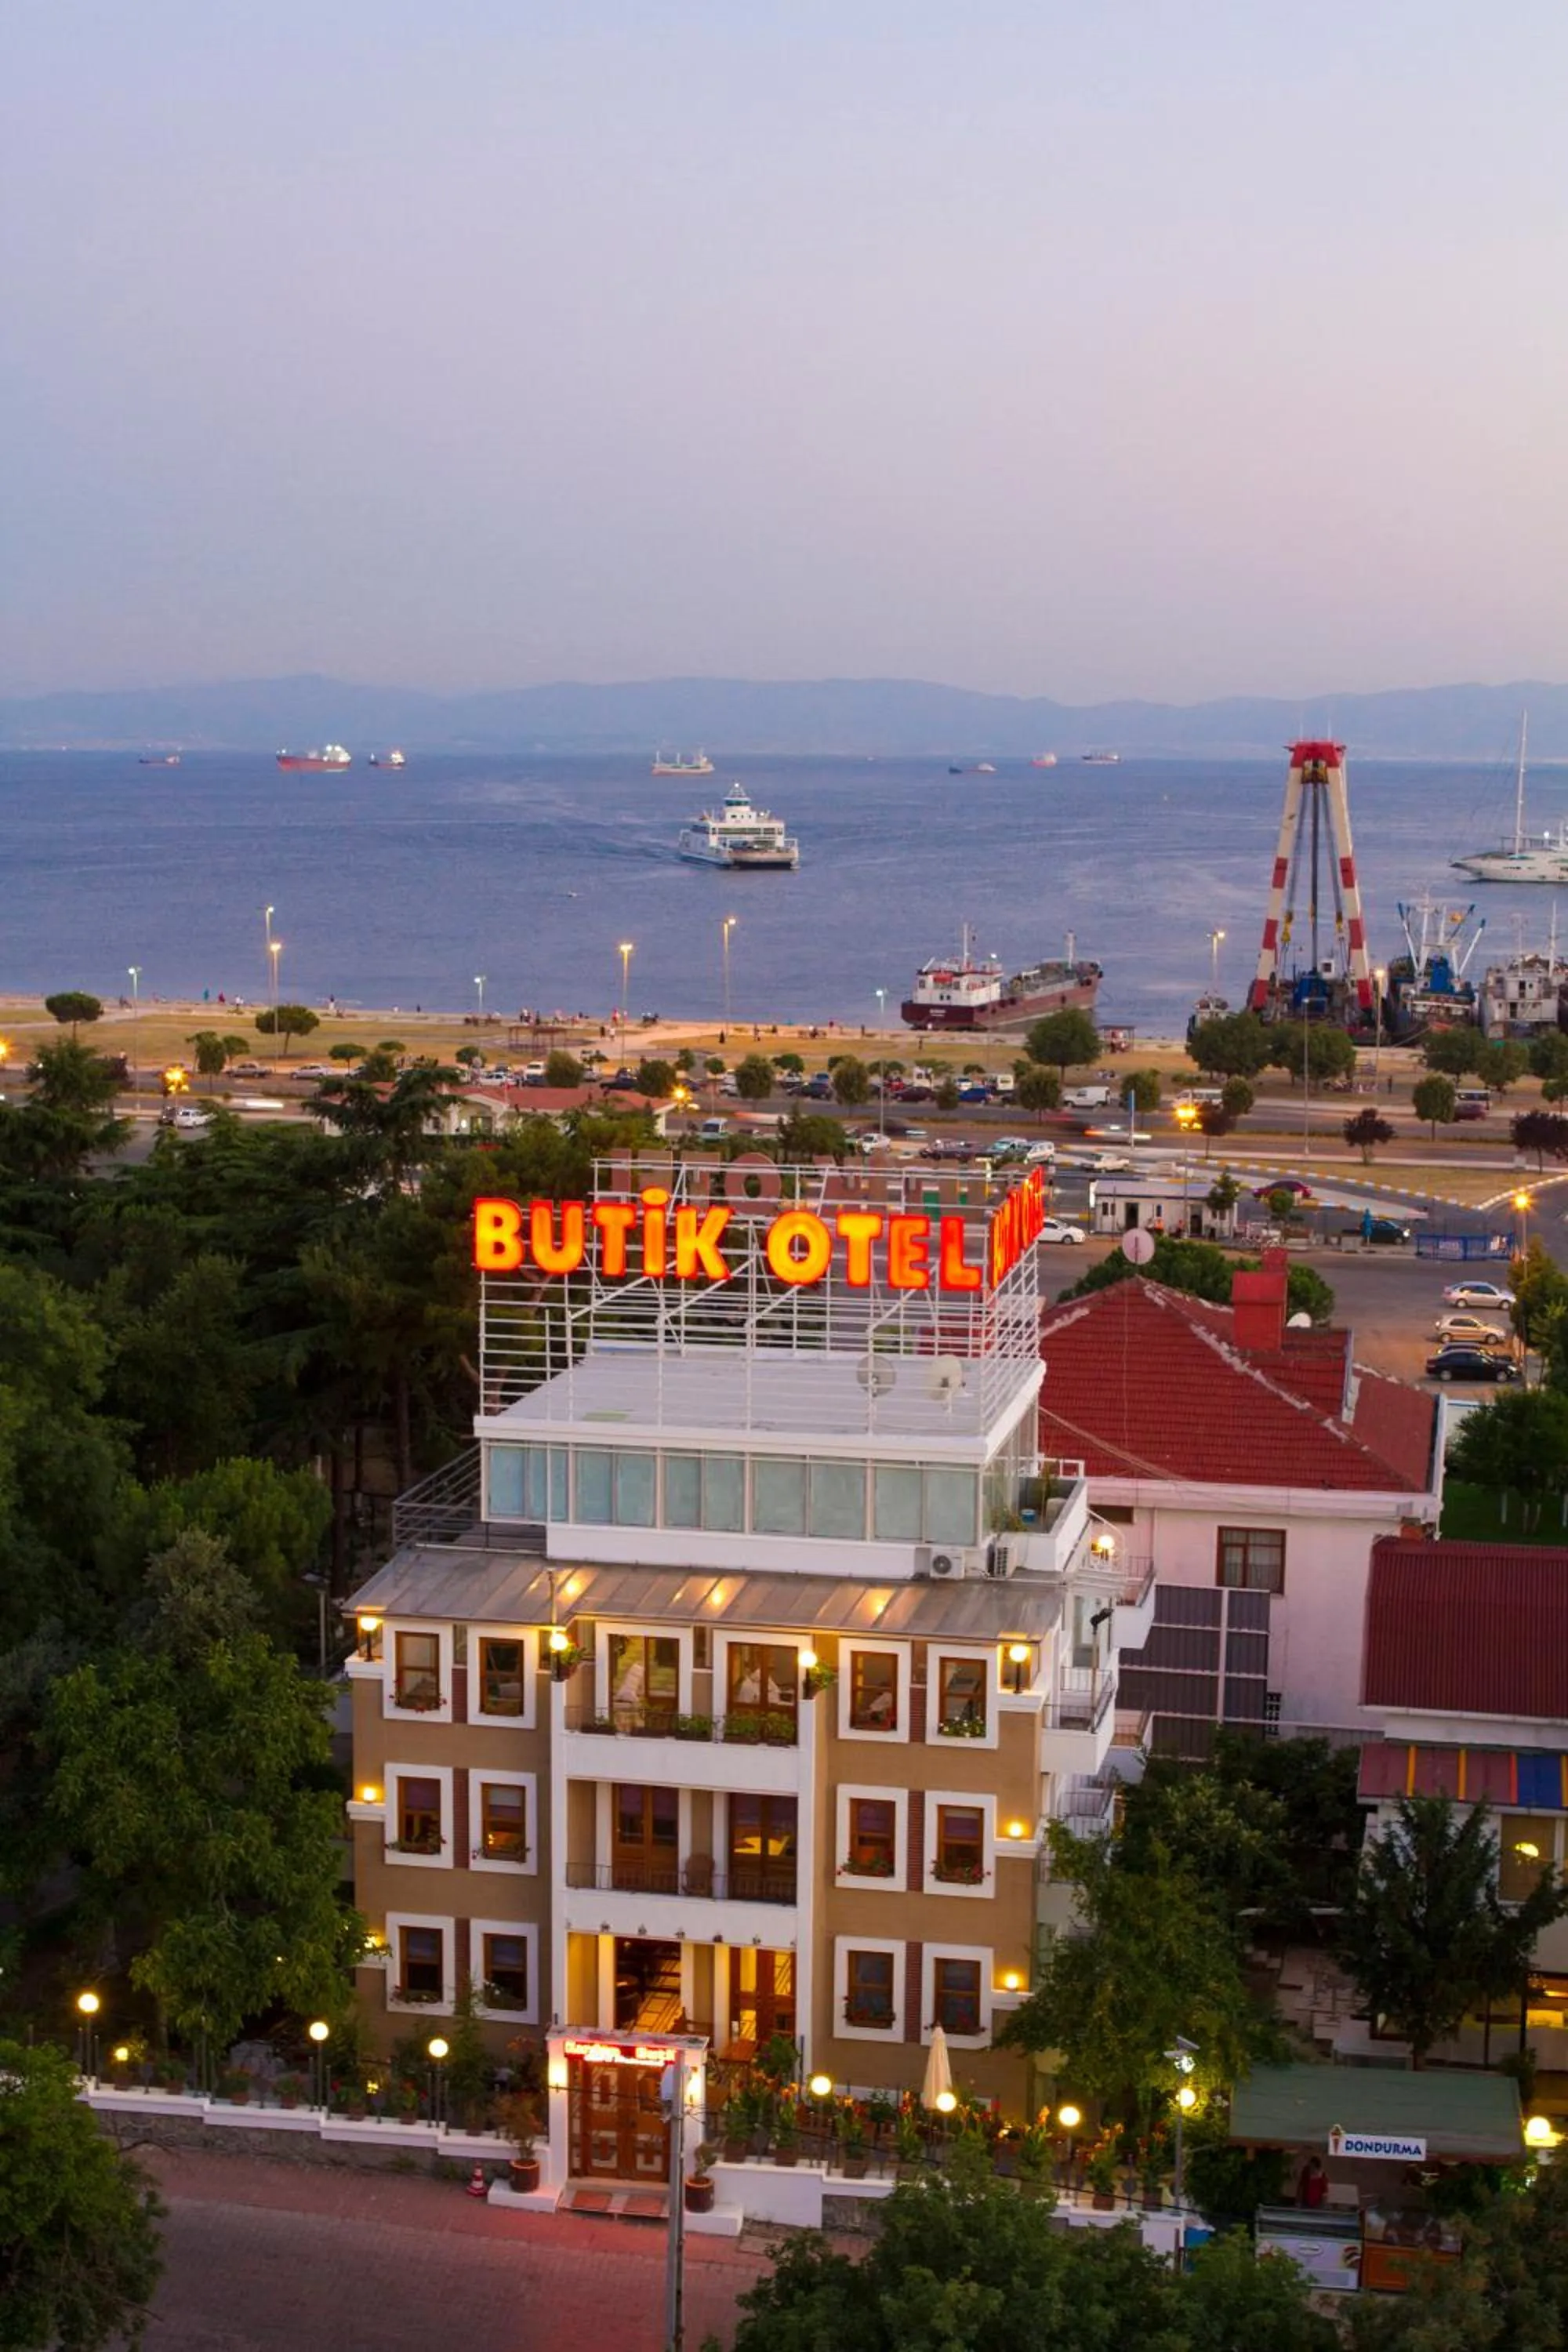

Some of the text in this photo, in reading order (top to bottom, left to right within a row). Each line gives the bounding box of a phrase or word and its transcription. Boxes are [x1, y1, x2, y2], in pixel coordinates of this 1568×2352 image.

[472, 1186, 734, 1280] BUTİK
[765, 1208, 982, 1291] OTEL
[1345, 2140, 1421, 2155] DONDURMA
